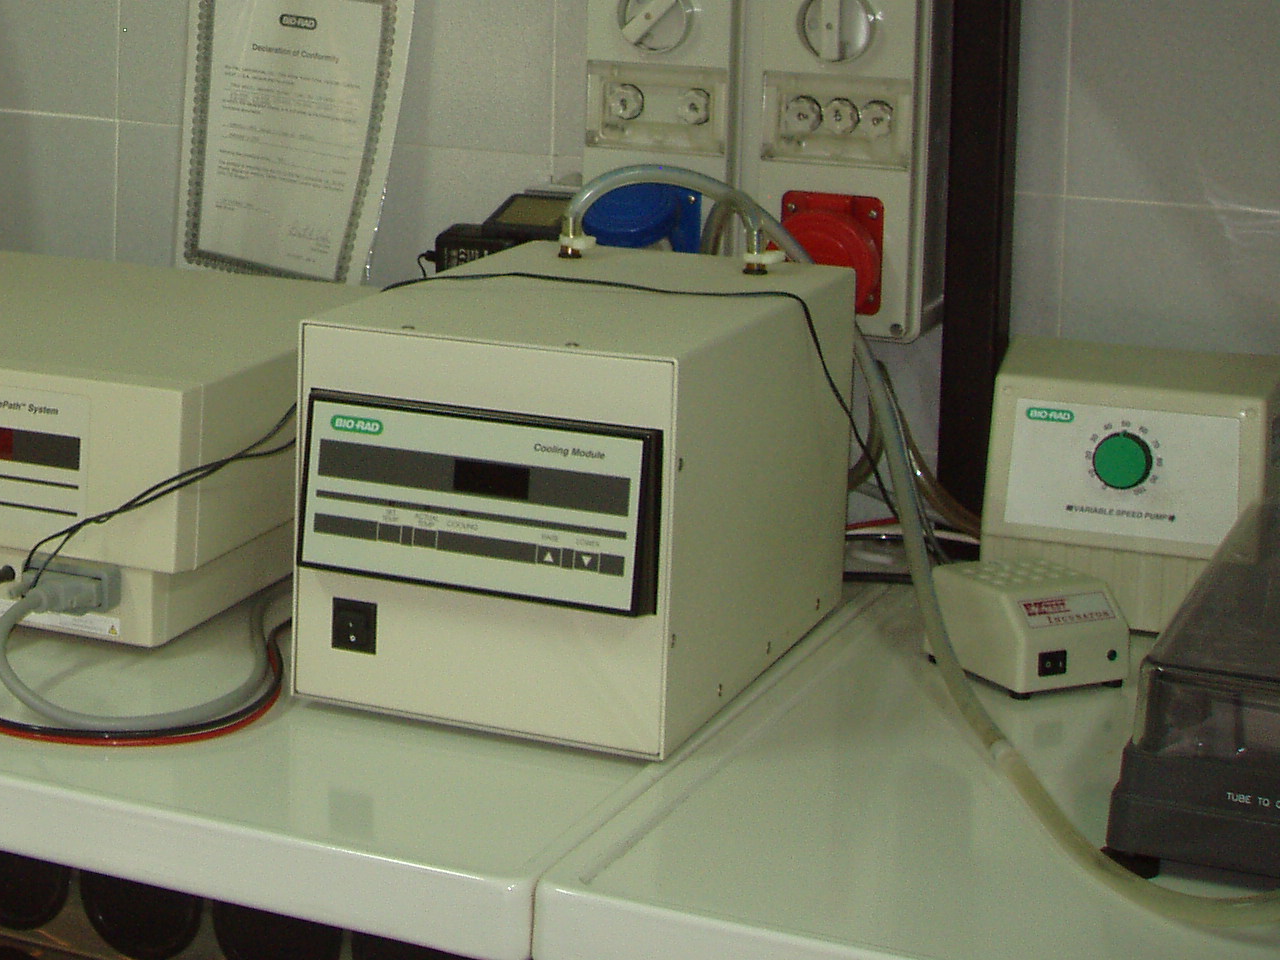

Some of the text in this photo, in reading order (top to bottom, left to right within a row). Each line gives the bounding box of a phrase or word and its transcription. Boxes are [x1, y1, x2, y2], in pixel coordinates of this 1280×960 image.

[252, 43, 291, 55] Declaration
[28, 403, 59, 415] System
[533, 443, 606, 459] Cooling Module
[1115, 509, 1143, 518] SPEED
[1144, 512, 1168, 520] PUMP
[1226, 791, 1252, 804] TUBE
[1258, 796, 1270, 807] TO
